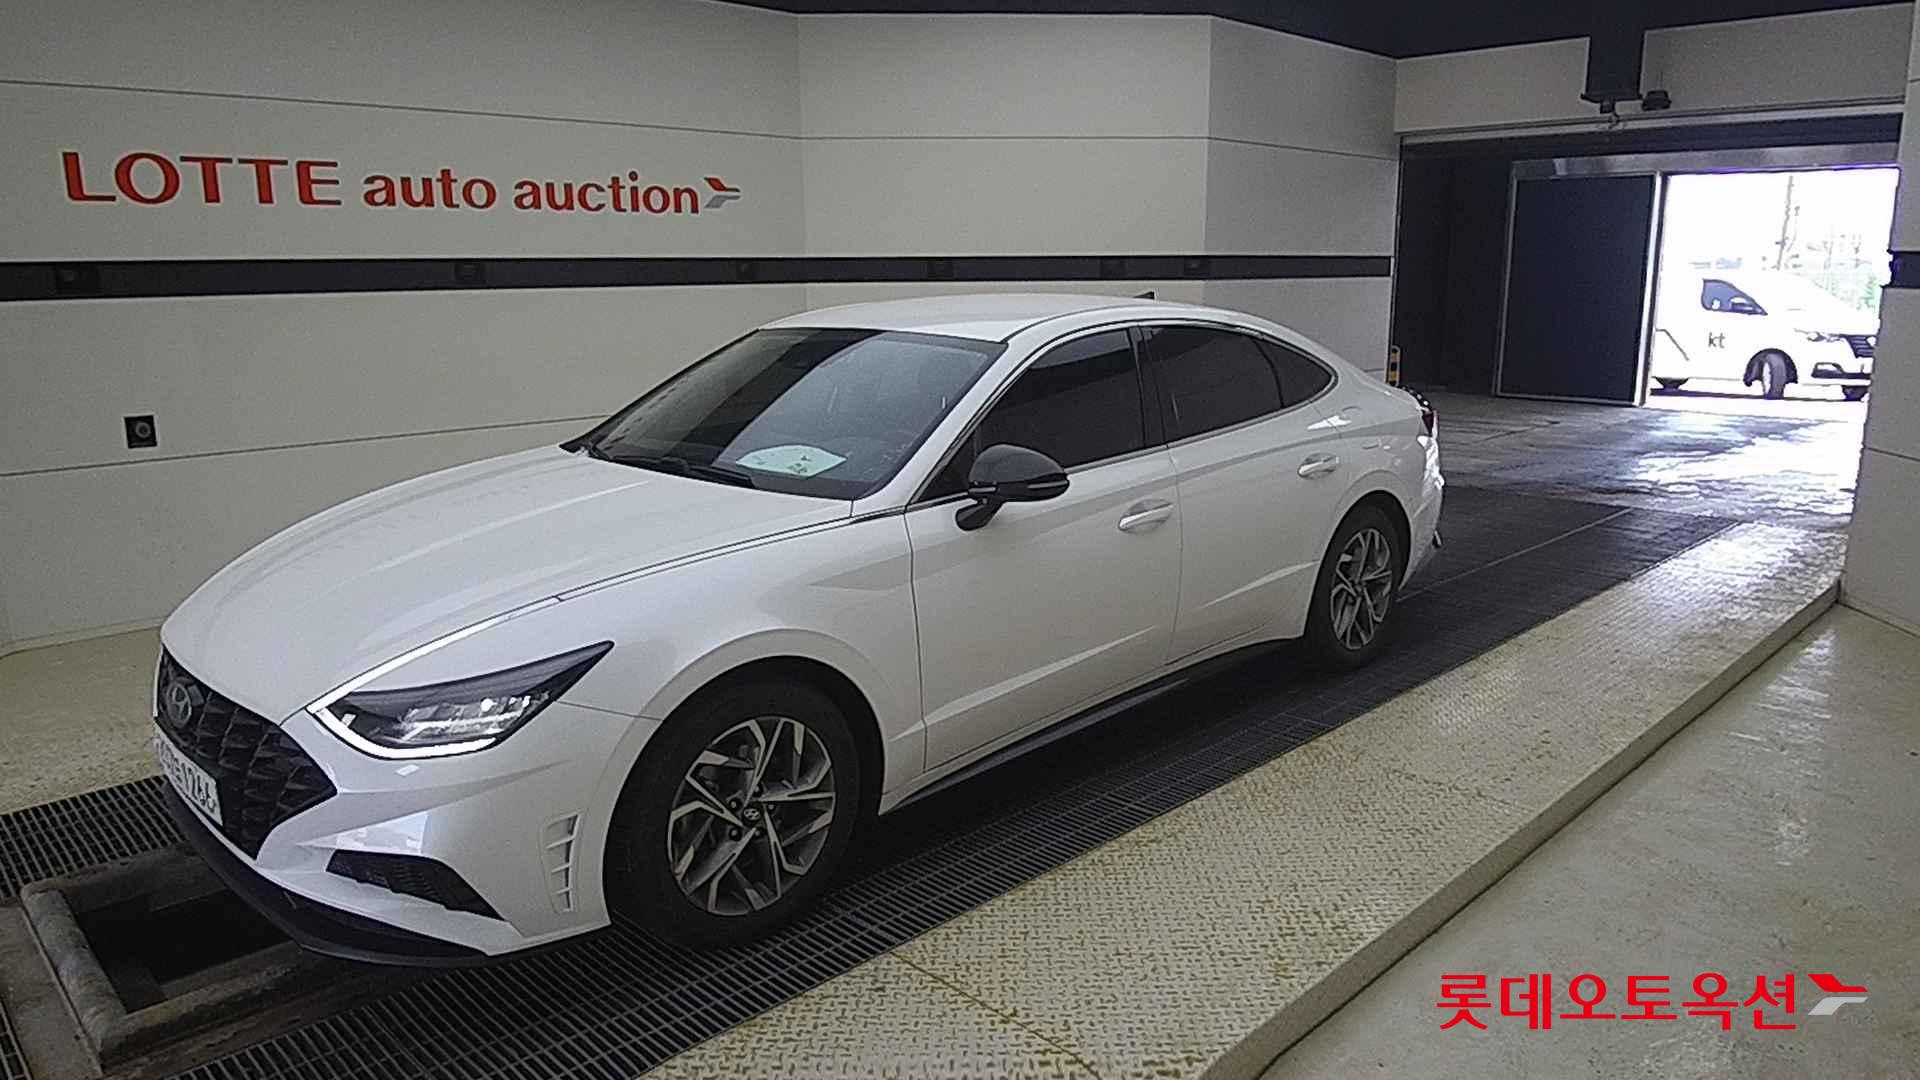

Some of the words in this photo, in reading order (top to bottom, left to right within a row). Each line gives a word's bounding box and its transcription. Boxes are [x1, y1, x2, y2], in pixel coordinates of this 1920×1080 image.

[63, 151, 342, 206] LOTTE
[363, 168, 497, 209] auto
[514, 170, 700, 214] auction
[1708, 332, 1725, 349] kt
